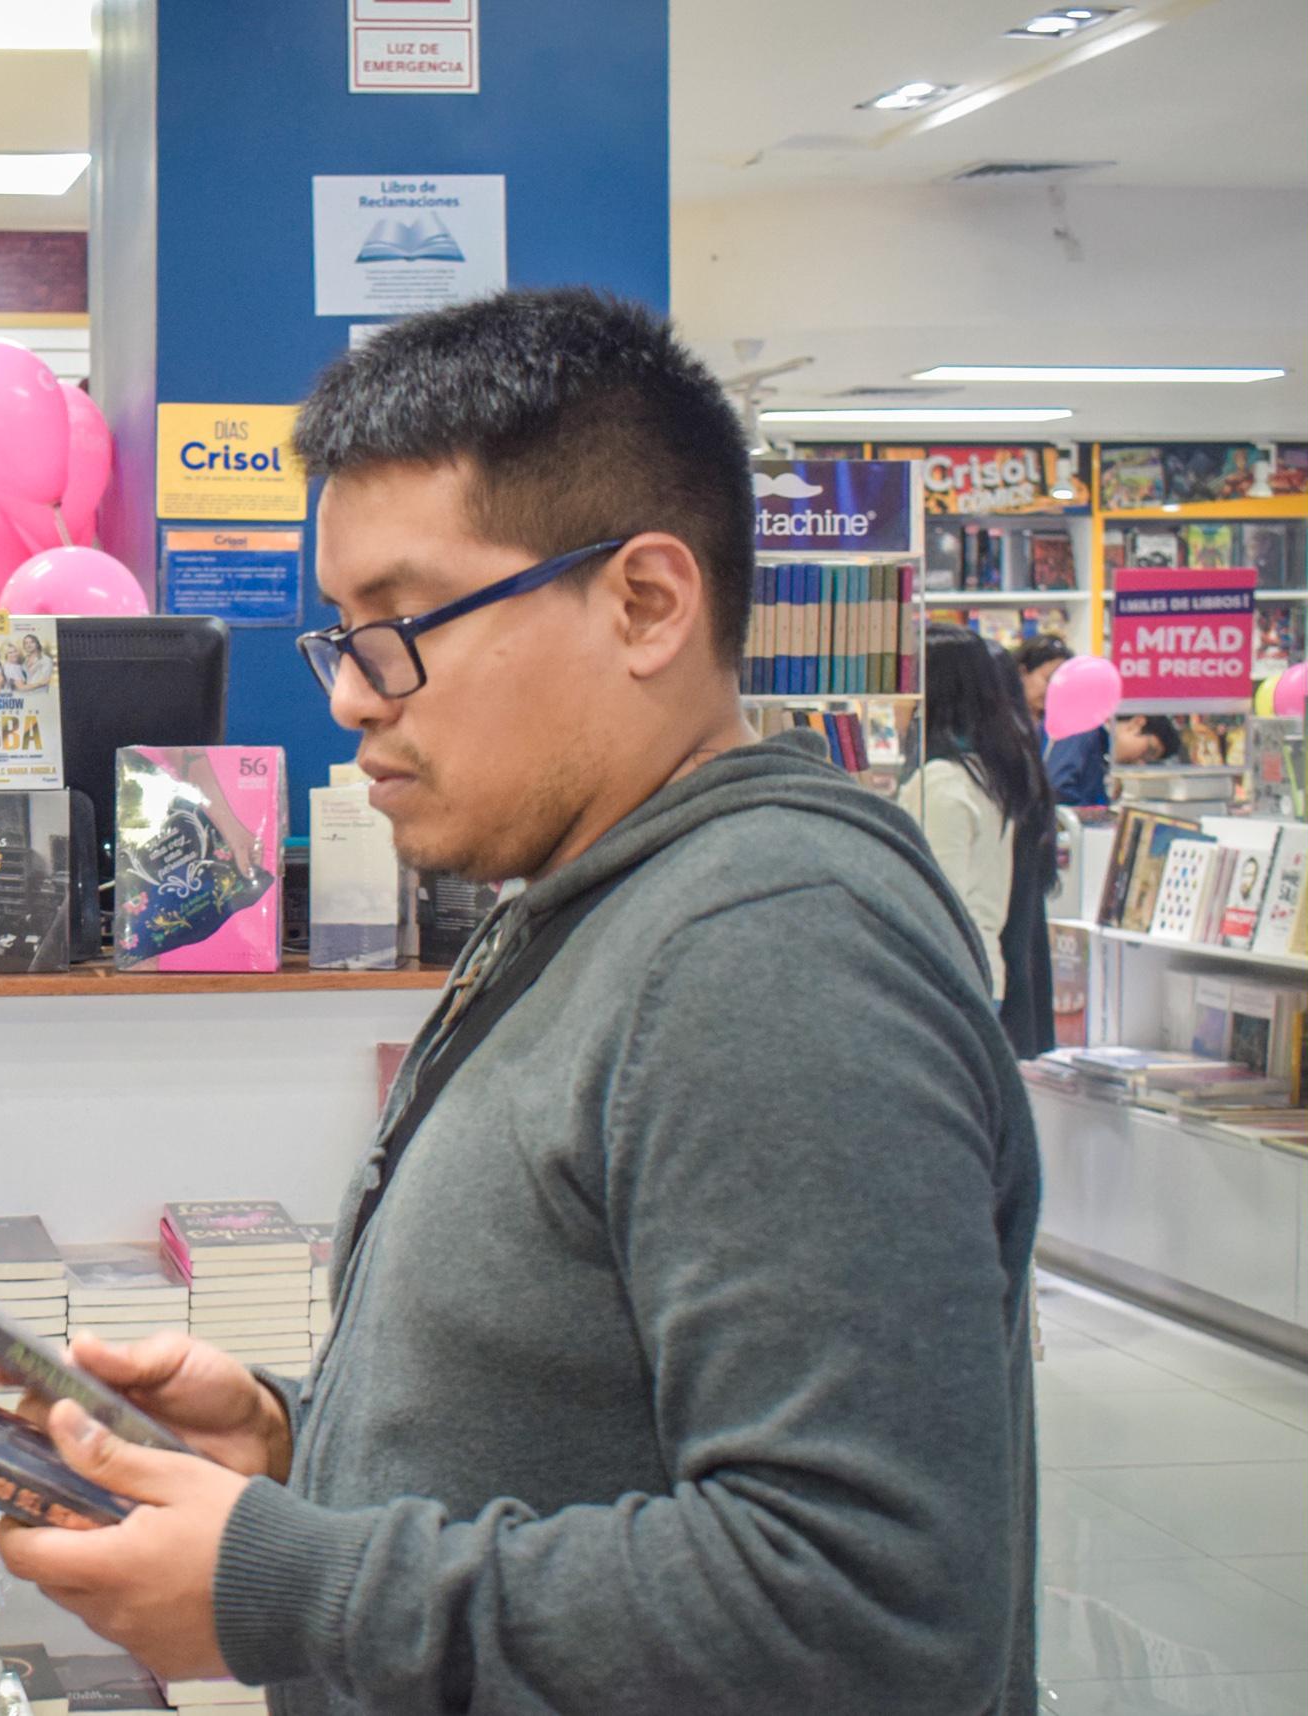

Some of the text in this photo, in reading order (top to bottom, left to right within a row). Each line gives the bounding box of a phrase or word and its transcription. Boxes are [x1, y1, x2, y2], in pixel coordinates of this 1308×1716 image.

[386, 43, 439, 55] LUZ DE
[362, 60, 465, 73] EMERGENCIA
[380, 181, 437, 193] Libro de
[358, 196, 460, 208] Reclamaciones
[215, 419, 249, 441] DÍAS
[180, 441, 282, 472] Crisol
[922, 449, 1042, 492] Crisol
[1120, 625, 1245, 654] A MITAD
[1119, 657, 1245, 679] DE PRECIO
[239, 757, 268, 777] 56
